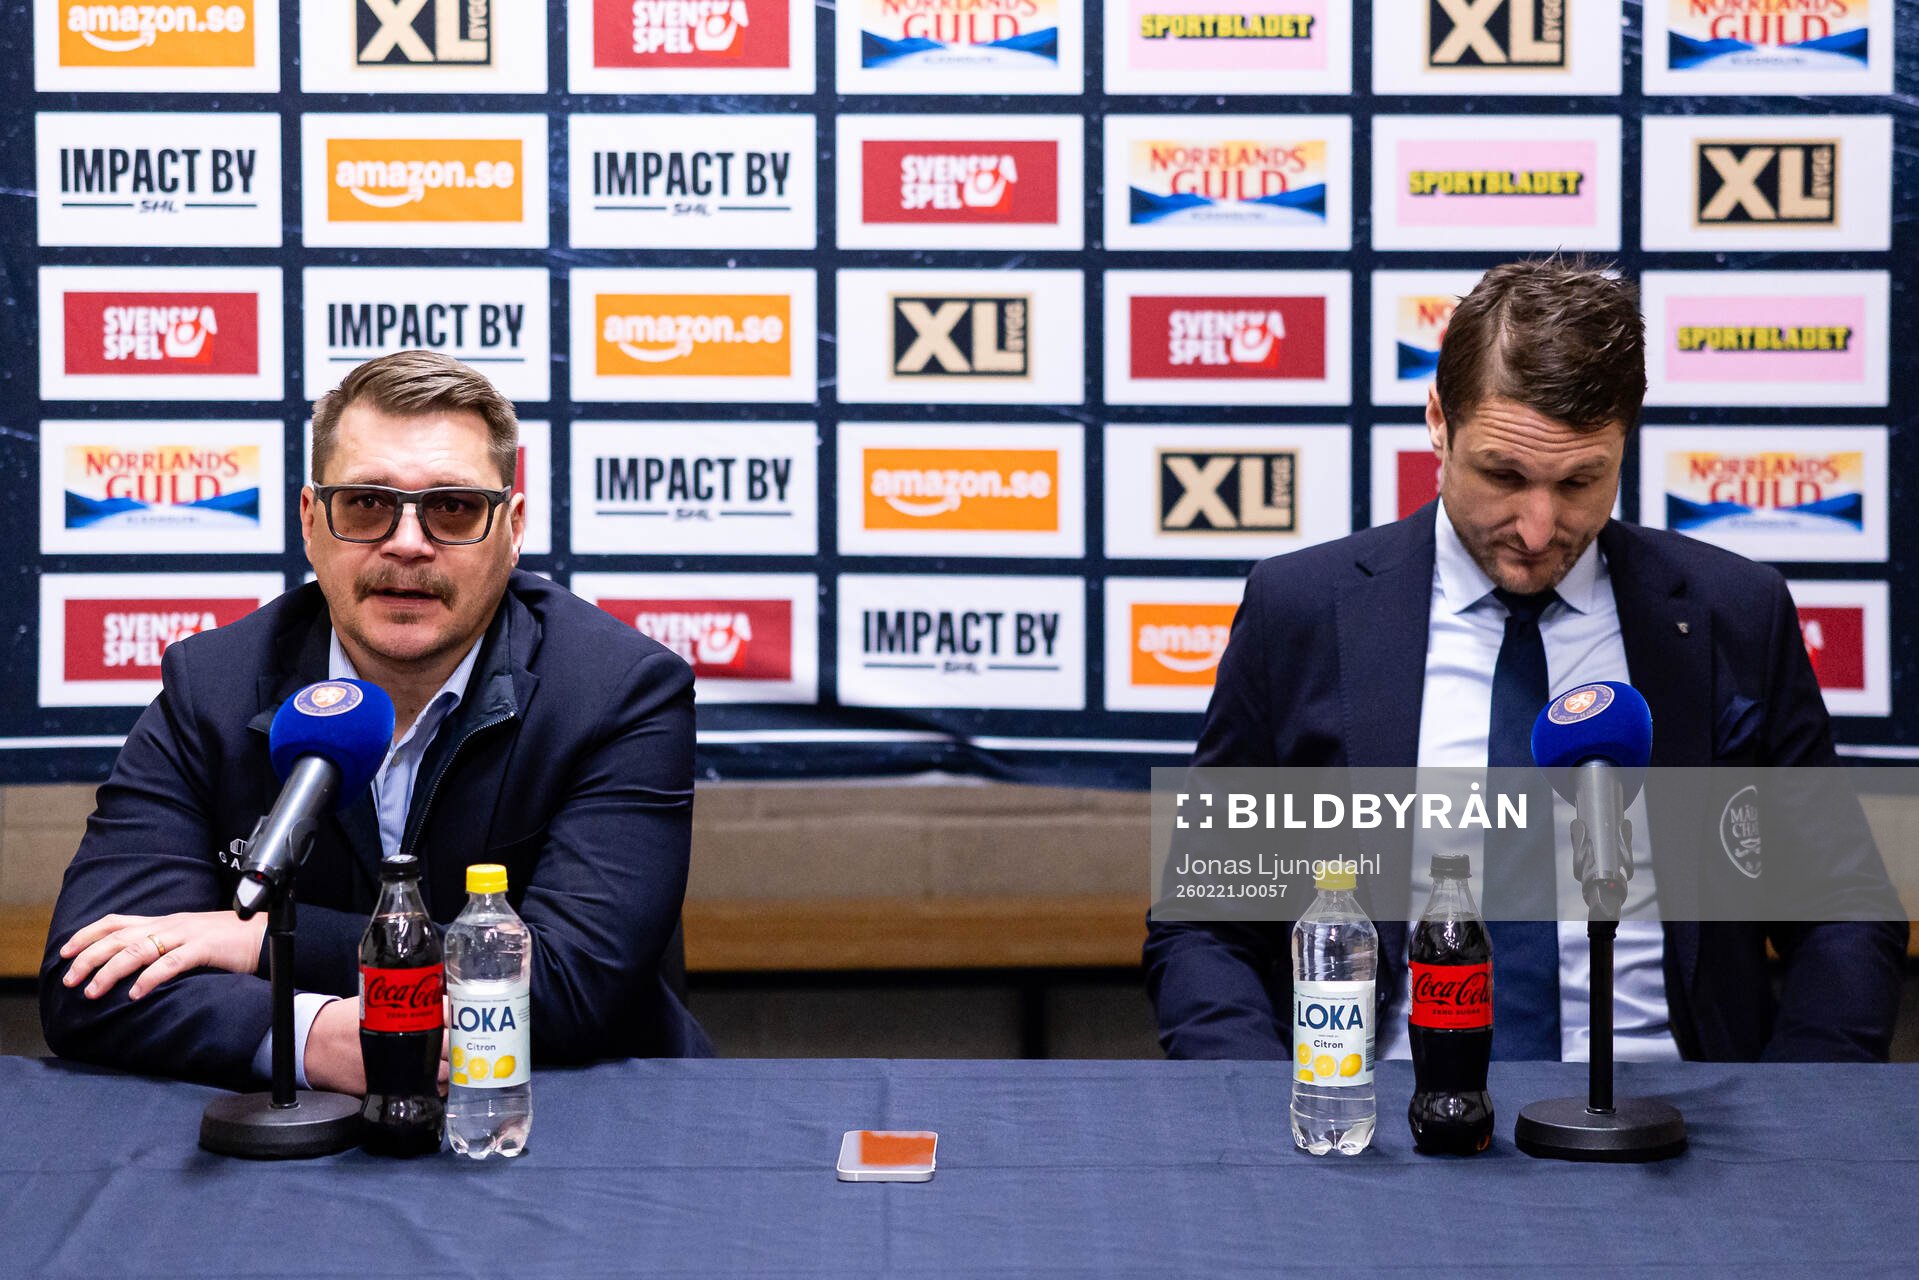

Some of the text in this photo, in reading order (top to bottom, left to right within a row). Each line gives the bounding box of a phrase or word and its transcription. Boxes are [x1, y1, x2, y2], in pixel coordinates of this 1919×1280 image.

[68, 5, 246, 33] amazon.se
[358, 0, 488, 62] XL
[903, 13, 1020, 45] GULD
[1140, 13, 1315, 40] SPORTBLADET
[1431, 0, 1562, 63] XL
[1710, 14, 1830, 46] GULD
[632, 27, 694, 54] SPEL
[60, 148, 256, 194] IMPACT BY
[335, 160, 515, 189] amazon.se
[594, 152, 791, 197] IMPACT BY
[1150, 147, 1307, 173] NORRLANDS
[901, 183, 963, 211] SPEL
[1171, 169, 1289, 202] GULD
[1408, 170, 1583, 196] SPORTBLADET
[1701, 146, 1832, 219] XL
[328, 303, 525, 349] IMPACT BY
[603, 315, 783, 344] amazon.se
[897, 301, 1026, 374] XL
[1677, 326, 1852, 352] SPORTBLADET
[103, 334, 164, 362] SPEL
[1169, 338, 1230, 366] SPEL
[85, 451, 239, 478] NORRLANDS
[1690, 457, 1839, 483] NORRLANDS
[106, 474, 222, 505] GULD
[595, 458, 792, 502] IMPACT BY
[870, 468, 1051, 500] amazon.se
[1163, 455, 1291, 528] XL
[1710, 479, 1823, 508] GULD
[863, 611, 1060, 656] IMPACT BY
[103, 640, 162, 667] SPEL
[450, 1004, 517, 1033] LOKA
[1297, 1000, 1364, 1031] LOKA
[466, 1042, 497, 1052] Citron
[1313, 1039, 1344, 1049] Citron
